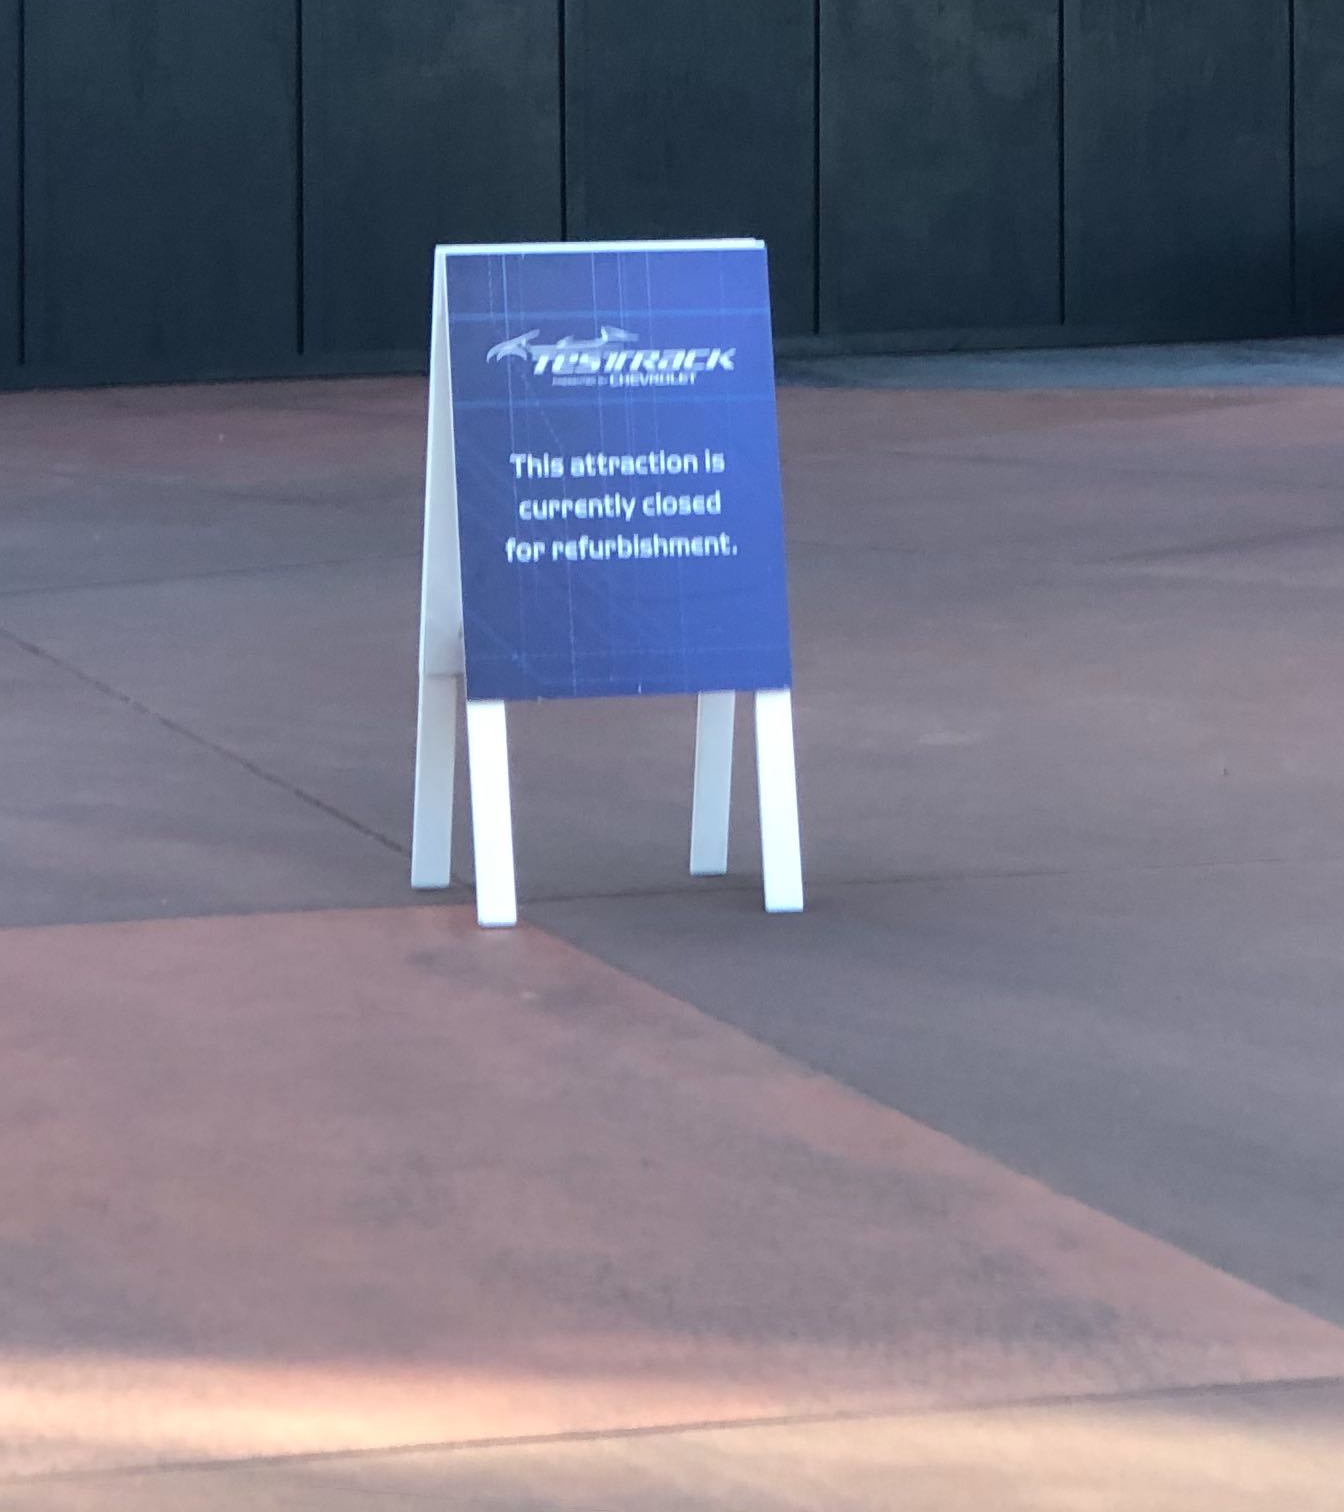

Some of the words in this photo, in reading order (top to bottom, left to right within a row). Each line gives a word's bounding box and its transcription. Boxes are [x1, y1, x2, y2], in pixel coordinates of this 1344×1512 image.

[509, 452, 564, 478] This
[570, 450, 698, 477] attraction
[705, 448, 725, 473] is
[519, 492, 636, 522] currently
[642, 489, 721, 517] closed
[506, 537, 545, 563] for
[552, 532, 738, 561] refurbishment.
